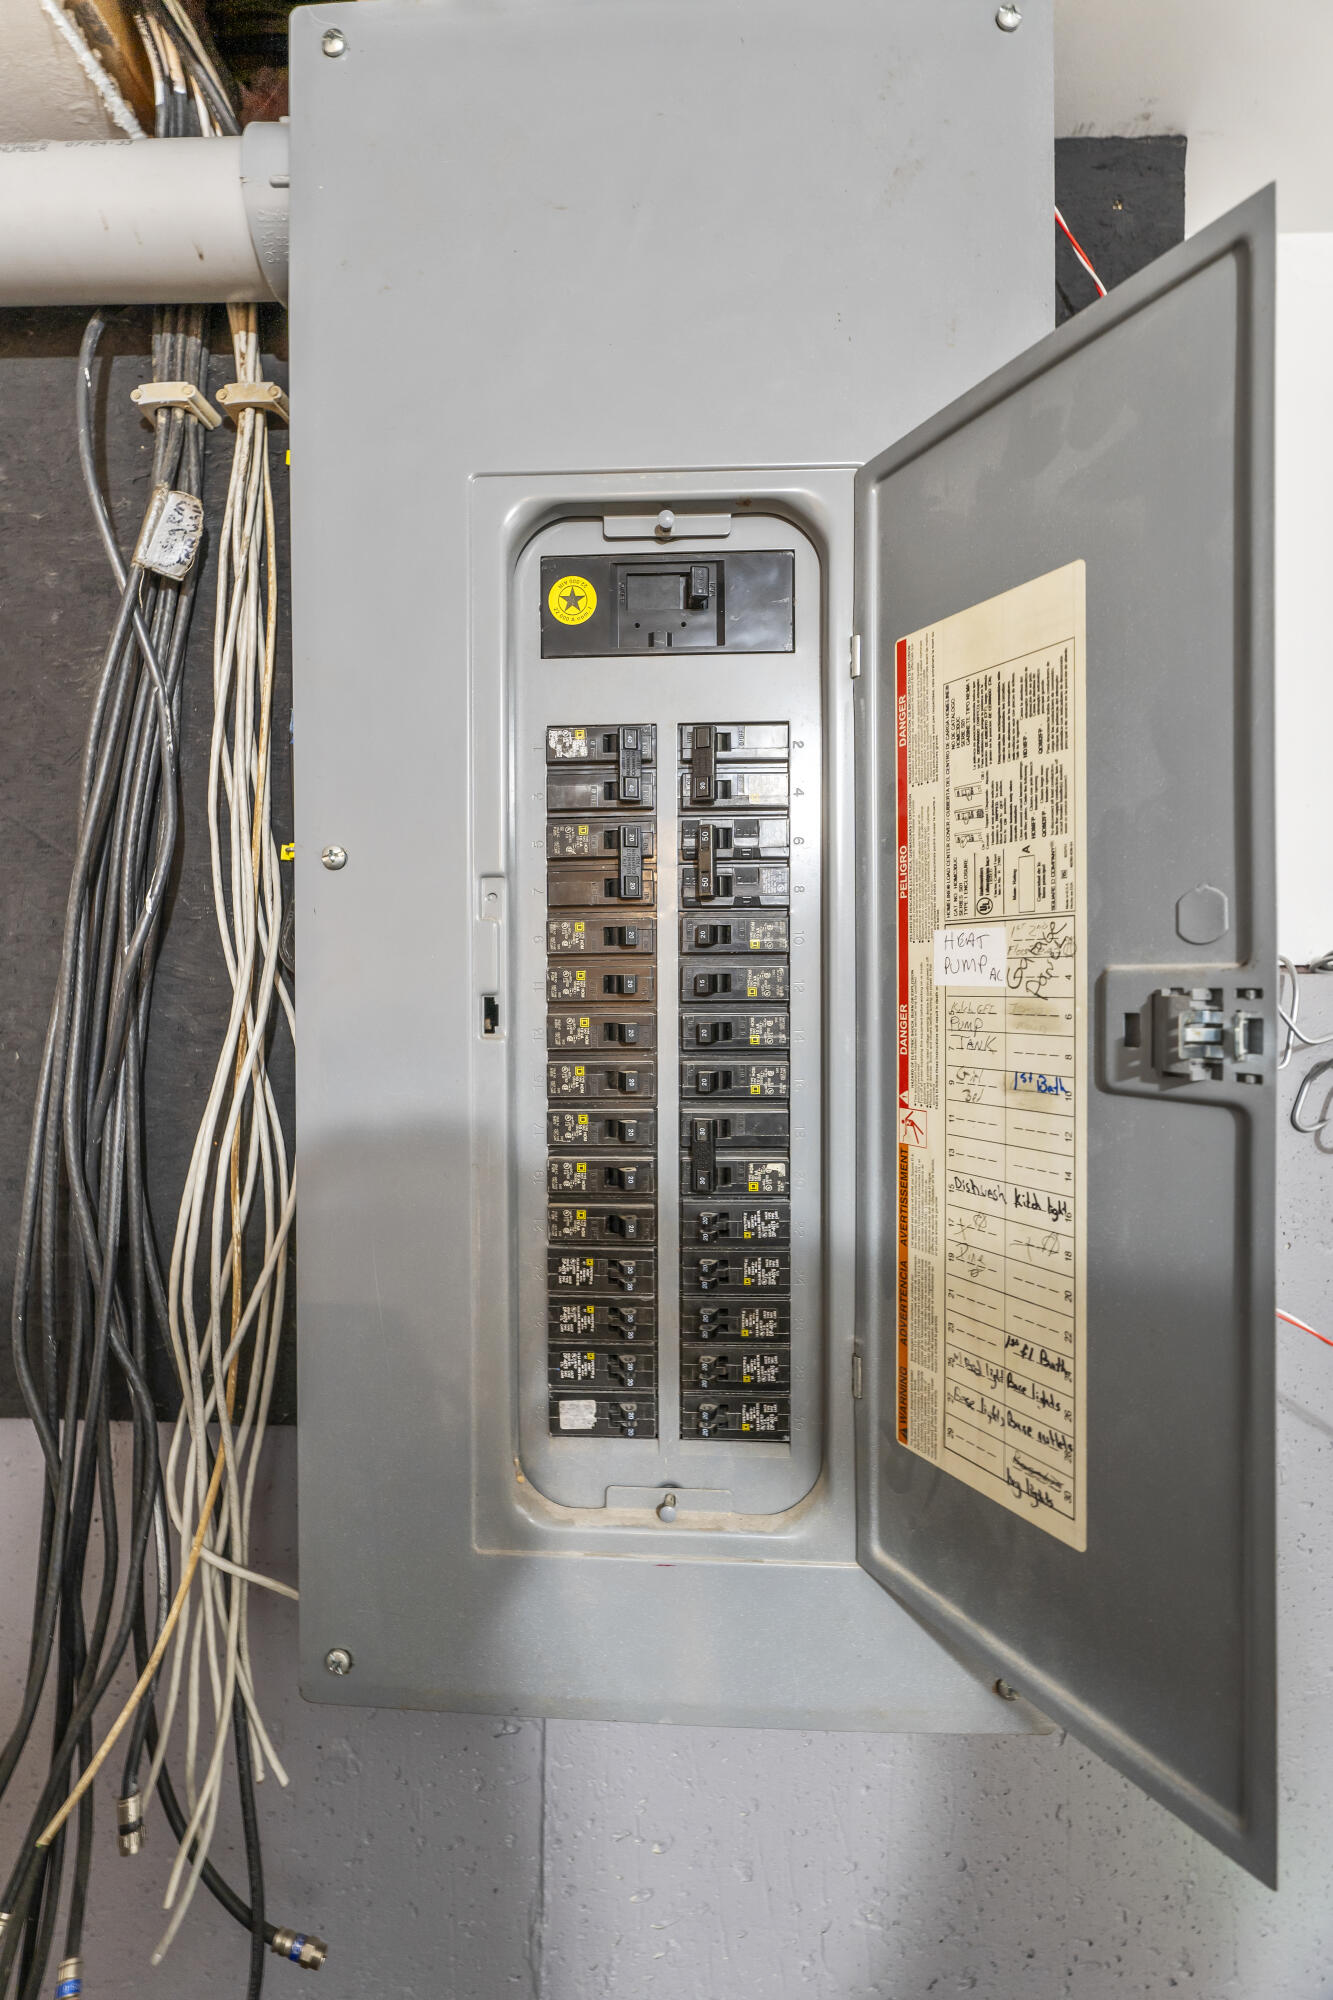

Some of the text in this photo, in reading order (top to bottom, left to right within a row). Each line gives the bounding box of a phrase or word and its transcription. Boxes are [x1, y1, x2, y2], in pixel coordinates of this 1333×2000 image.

[898, 694, 908, 748] DANGER
[793, 740, 804, 749] 2
[793, 788, 804, 797] 4
[629, 833, 634, 842] 20
[702, 832, 708, 842] 50
[793, 837, 804, 845] 6
[1022, 845, 1030, 854] A
[900, 844, 908, 899] PELIGRO
[630, 882, 635, 890] 20
[702, 877, 708, 888] 50
[944, 931, 990, 951] HEAT
[944, 954, 1004, 981] PUMP AC
[900, 1003, 908, 1055] DANGER
[950, 1016, 984, 1037] PUMP
[950, 1034, 997, 1052] TANK
[1014, 1072, 1068, 1096] 1st Bath
[1065, 1092, 1073, 1101] 10
[949, 1114, 955, 1122] 11
[1065, 1132, 1073, 1142] 12
[948, 1148, 956, 1157] 13
[1064, 1171, 1072, 1181] 14
[900, 1148, 908, 1247] AVERTISSEMENT
[1065, 1212, 1072, 1222] 16
[948, 1218, 955, 1227] 17
[948, 1253, 955, 1262] 19
[1064, 1251, 1072, 1261] 18
[948, 1288, 955, 1298] 21
[1064, 1290, 1072, 1303] 20
[900, 1260, 908, 1347] ADVERTENCIA
[1064, 1332, 1072, 1343] 22
[1040, 1348, 1066, 1373] Bath
[899, 1366, 908, 1424] WARNING
